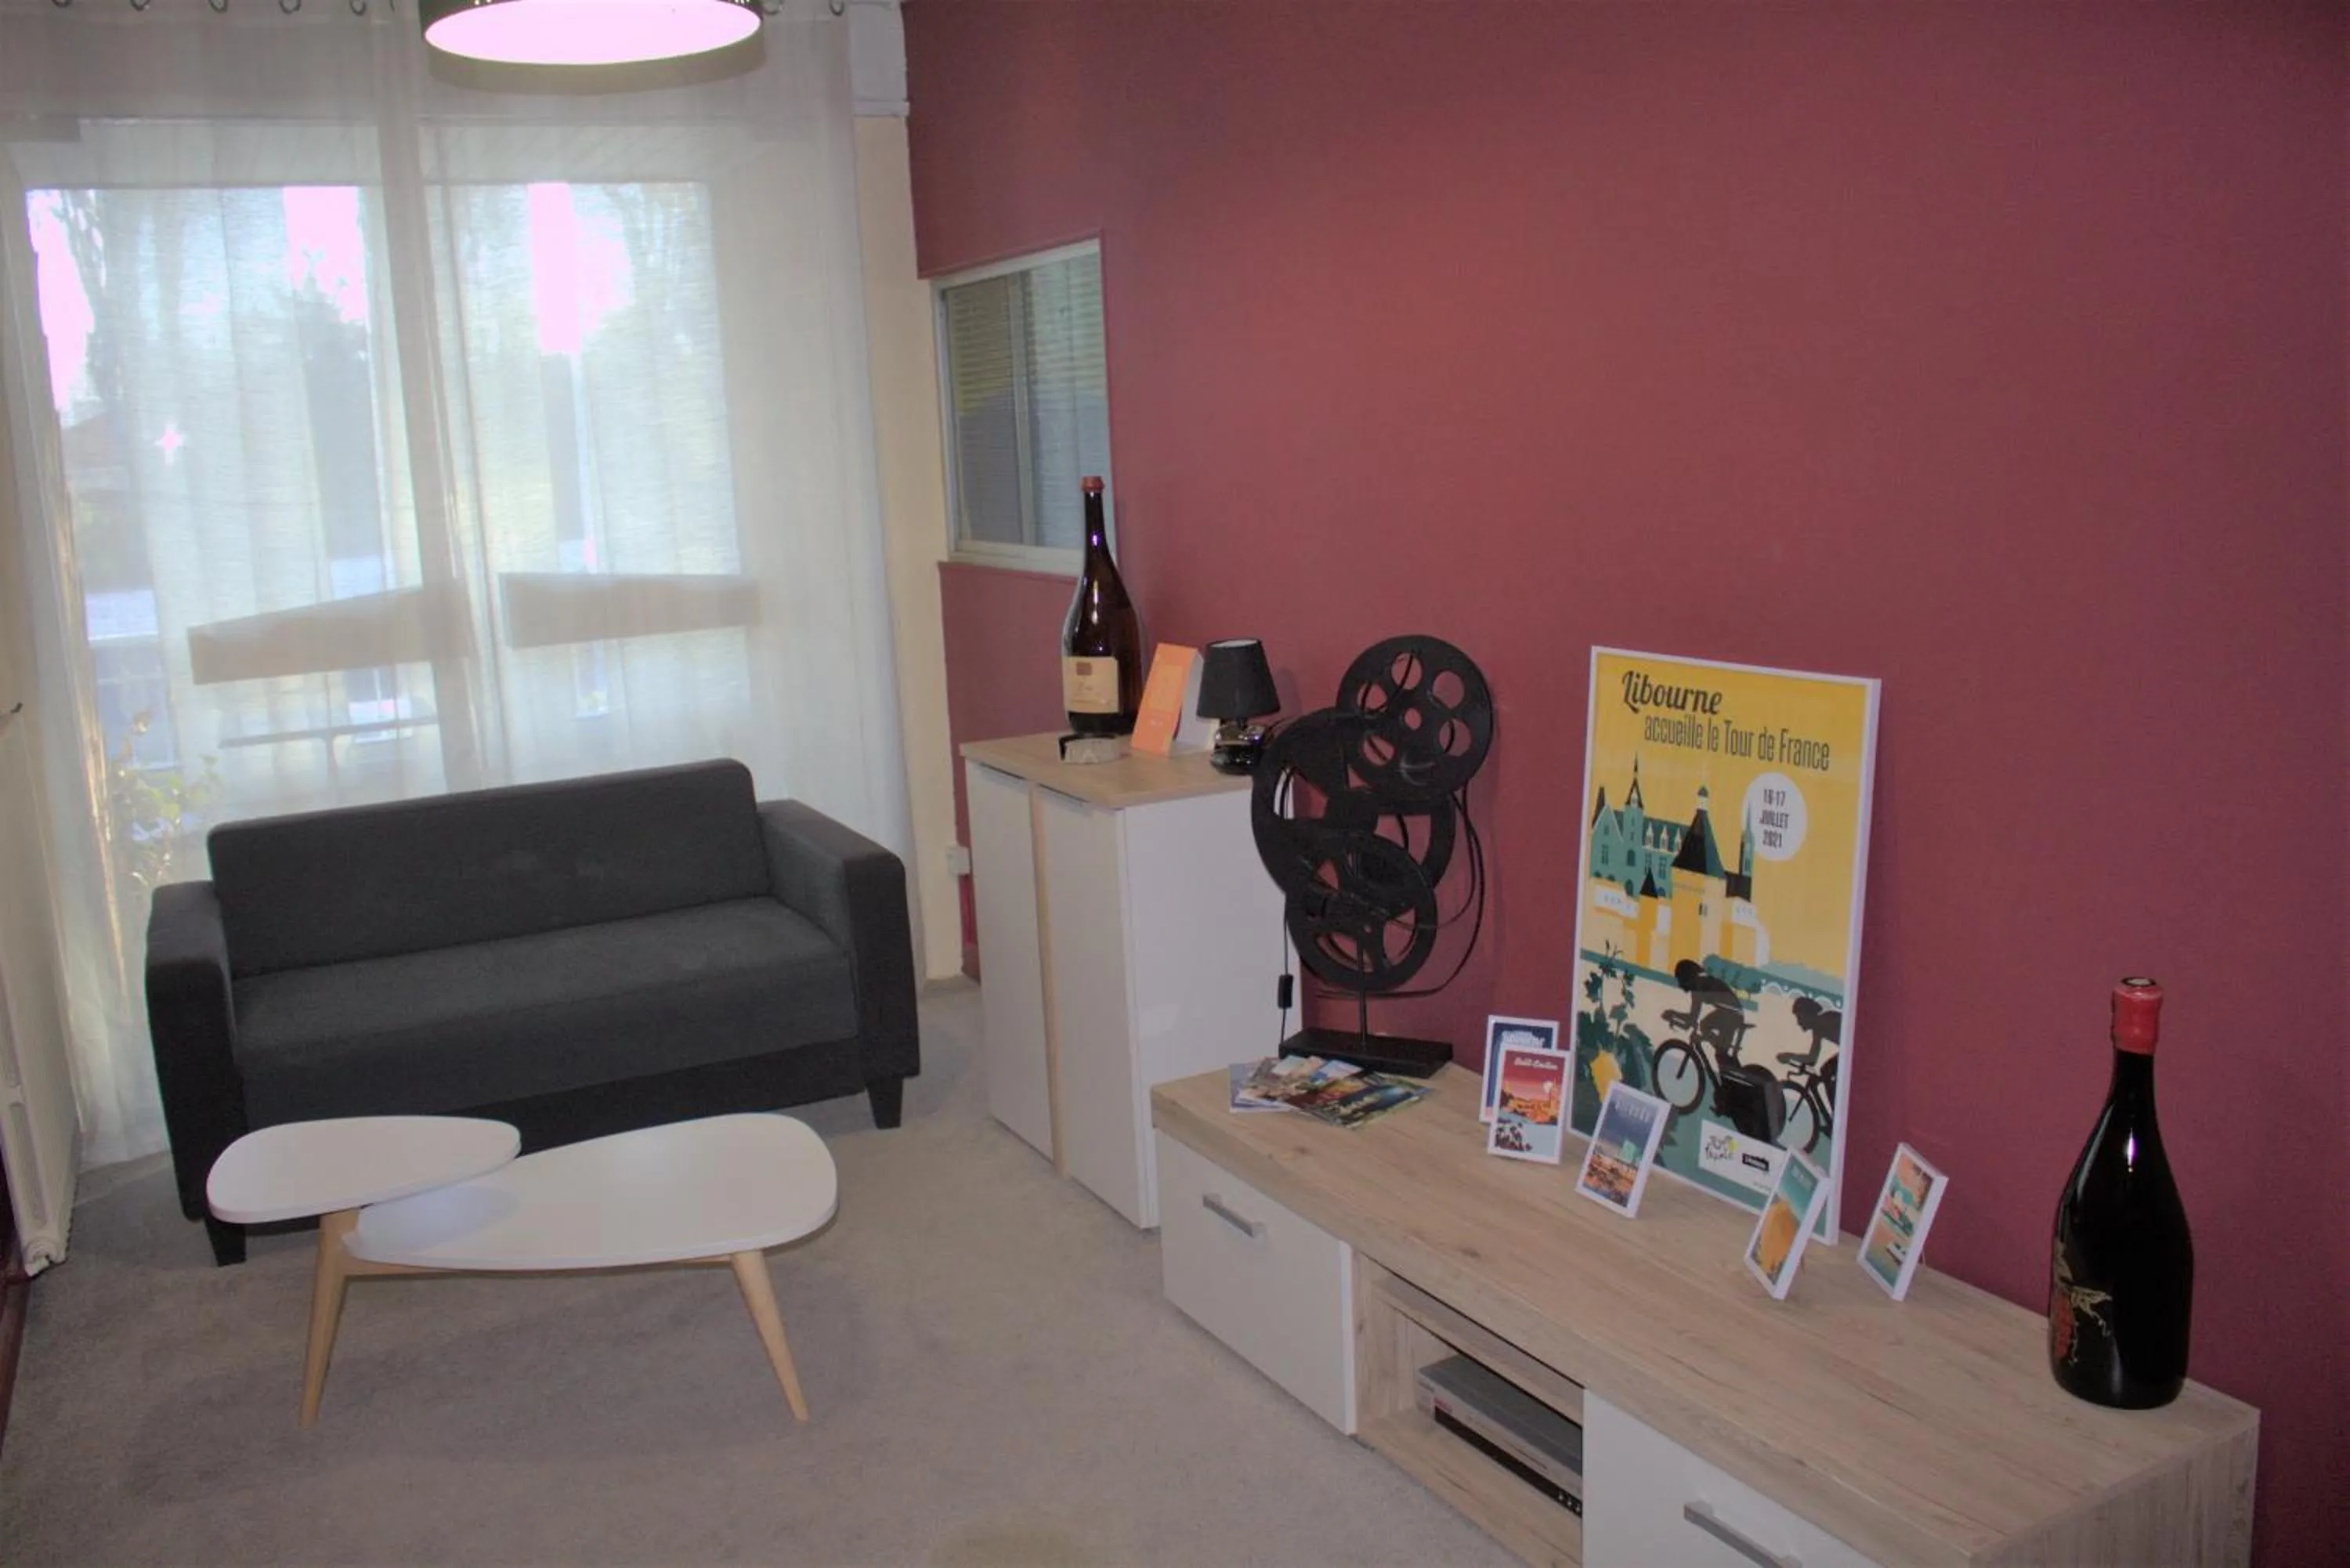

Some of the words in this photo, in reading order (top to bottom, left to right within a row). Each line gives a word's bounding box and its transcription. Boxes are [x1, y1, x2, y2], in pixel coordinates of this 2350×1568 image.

[1622, 670, 1723, 714] Libourne
[1645, 714, 1703, 750] accueille
[1707, 717, 1719, 753] le
[1724, 719, 1755, 758] Tour
[1758, 726, 1774, 763] de
[1779, 728, 1830, 771] France
[1759, 810, 1789, 829] JUILLET
